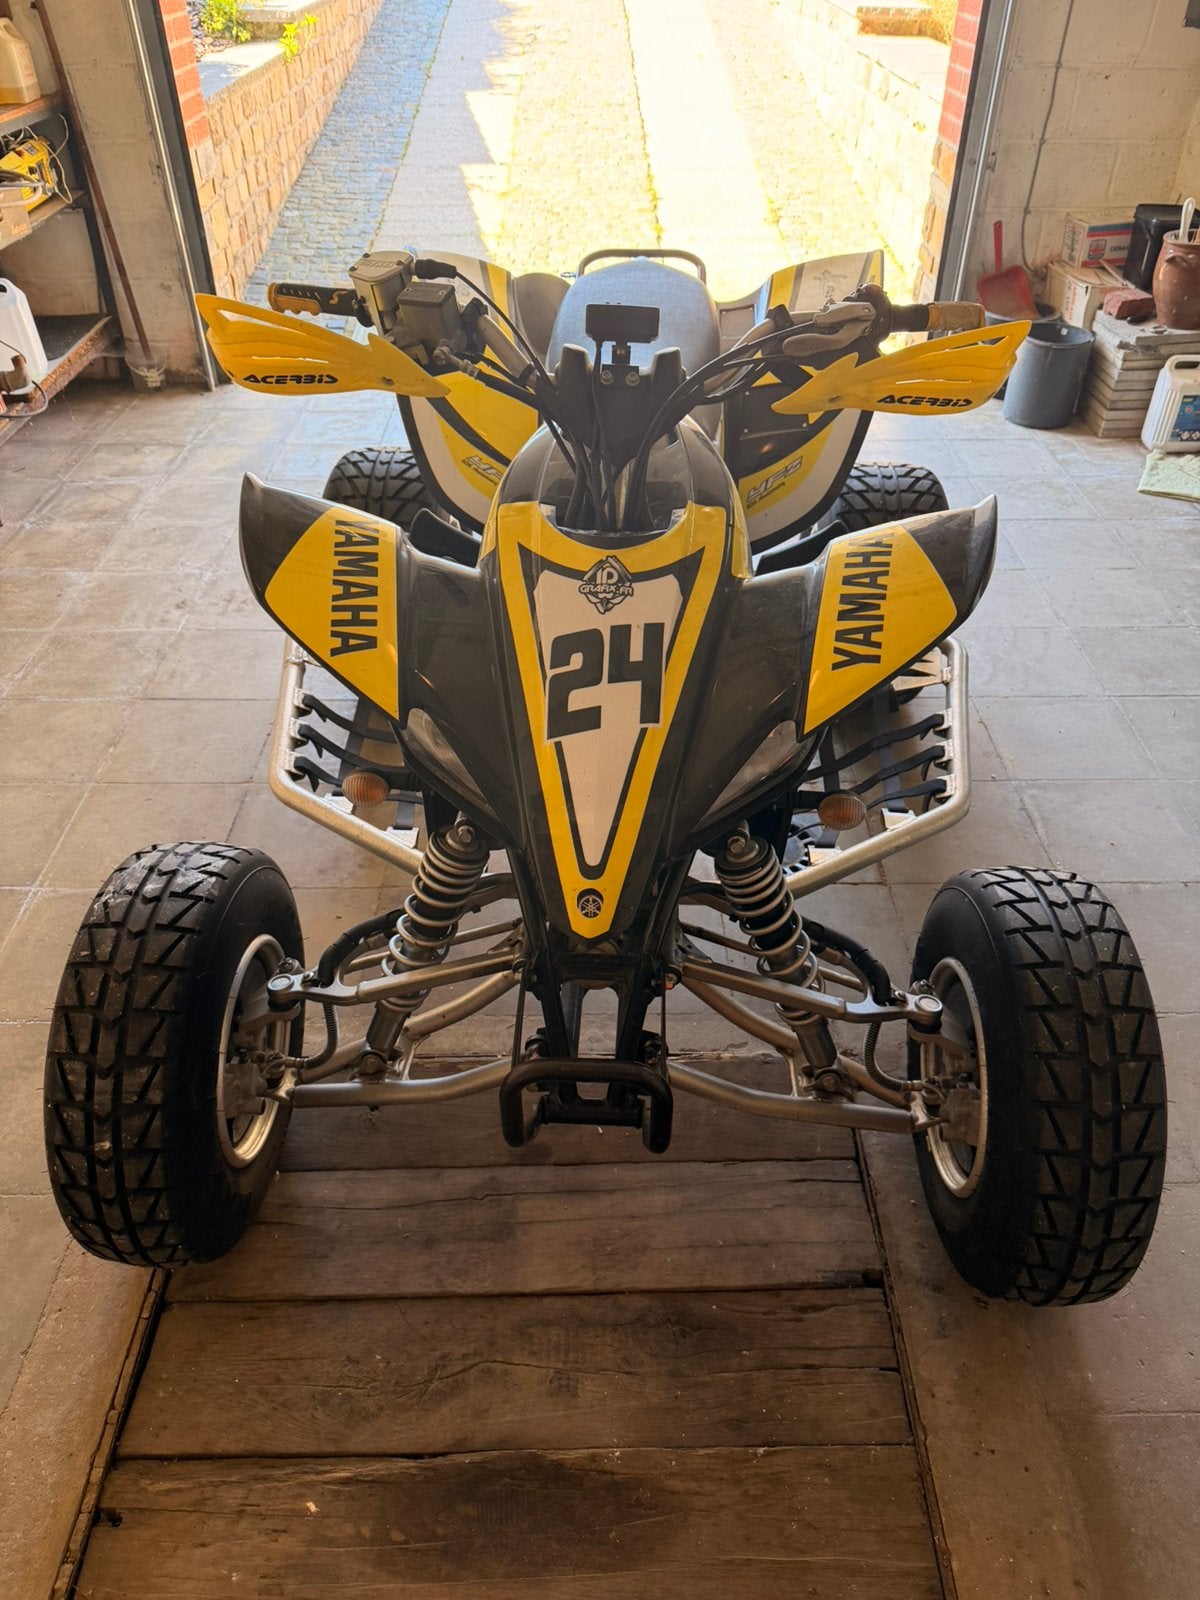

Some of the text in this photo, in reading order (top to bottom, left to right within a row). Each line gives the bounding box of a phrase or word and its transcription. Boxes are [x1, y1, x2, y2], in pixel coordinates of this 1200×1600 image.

[330, 519, 380, 658] YAMAHA
[831, 531, 896, 671] YAMAHA
[546, 622, 665, 741] 24
